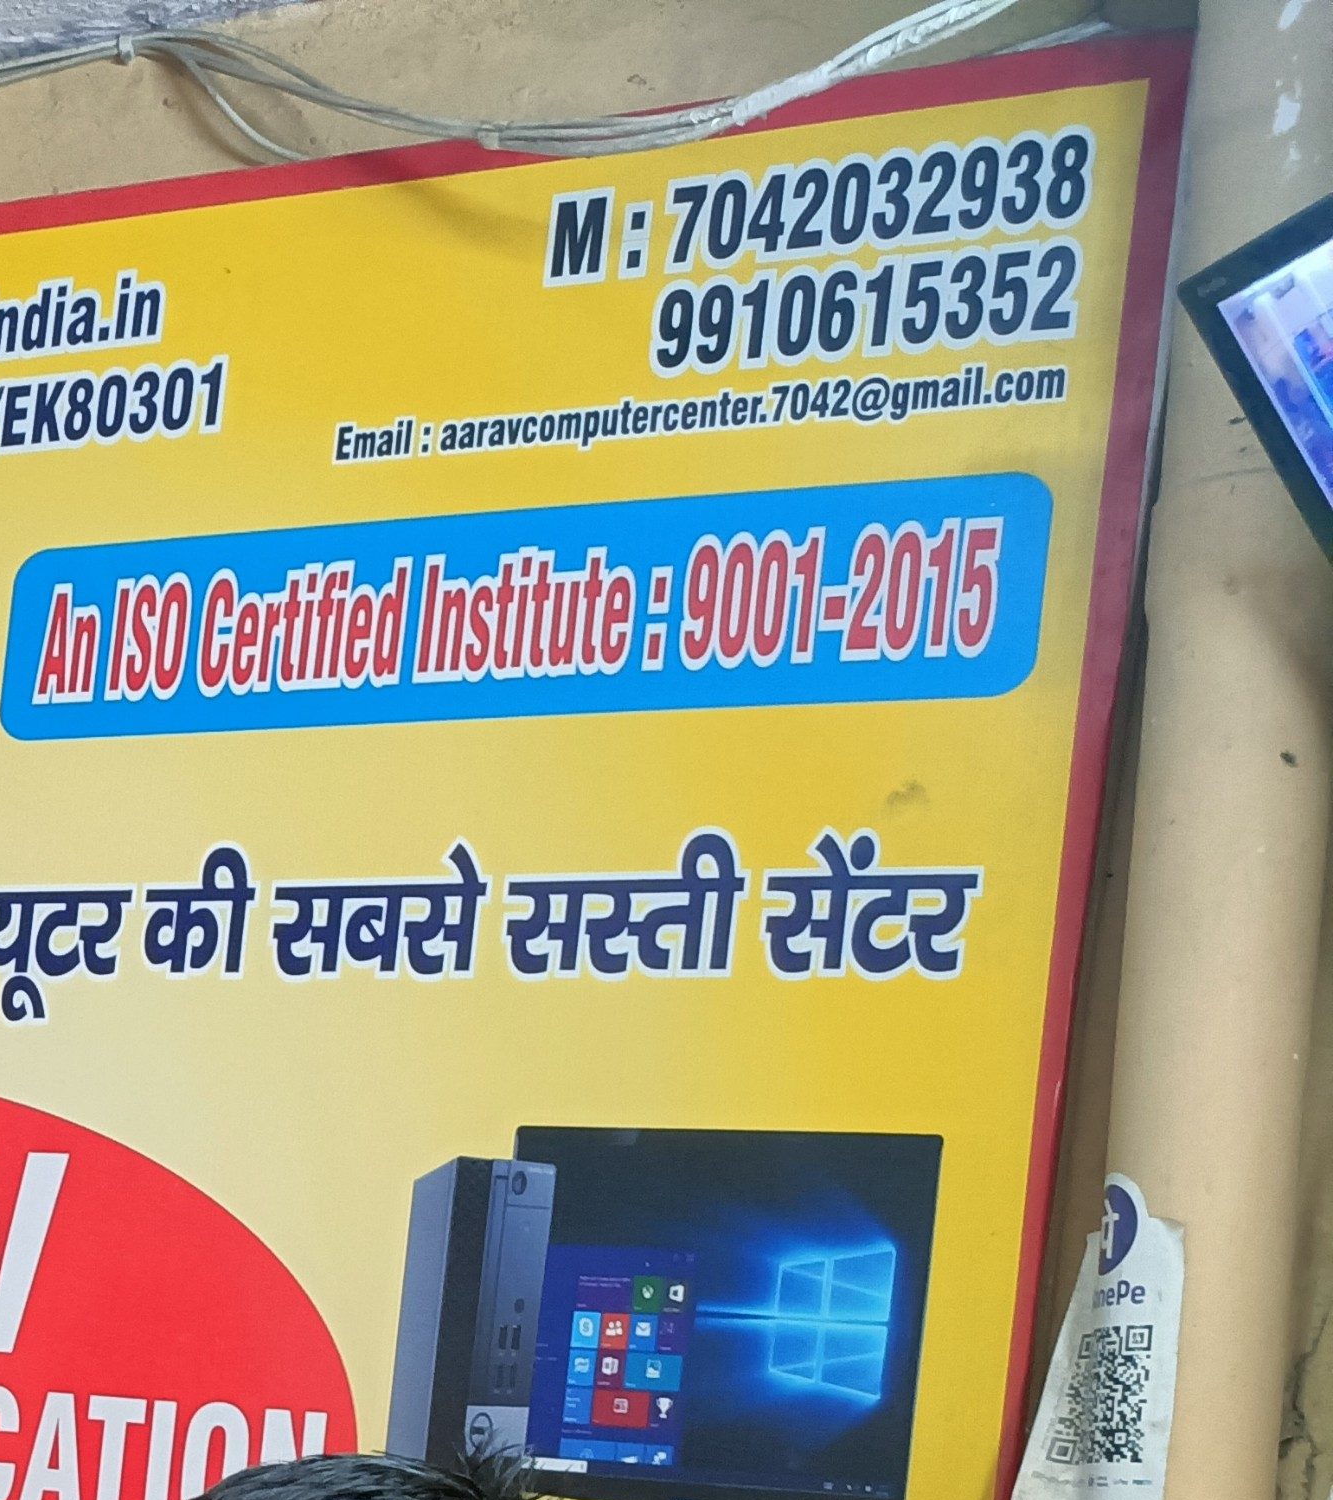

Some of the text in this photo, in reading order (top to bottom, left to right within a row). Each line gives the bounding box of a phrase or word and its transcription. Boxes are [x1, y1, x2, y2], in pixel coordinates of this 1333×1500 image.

[553, 199, 606, 277] M
[668, 135, 1088, 266] 7042032938
[658, 247, 1077, 369] 9910615352
[336, 421, 412, 463] Email
[439, 368, 1065, 451] aaravcomputercenter.7042@gmail.com
[38, 593, 97, 696] An
[109, 581, 191, 690] ISO
[200, 555, 407, 690] Certified
[419, 555, 629, 674] Institute
[683, 528, 999, 664] 9001-2015
[145, 847, 254, 974] की
[272, 844, 485, 974] सबसे
[506, 833, 743, 974] सस्ती
[766, 833, 979, 974] सेंटर
